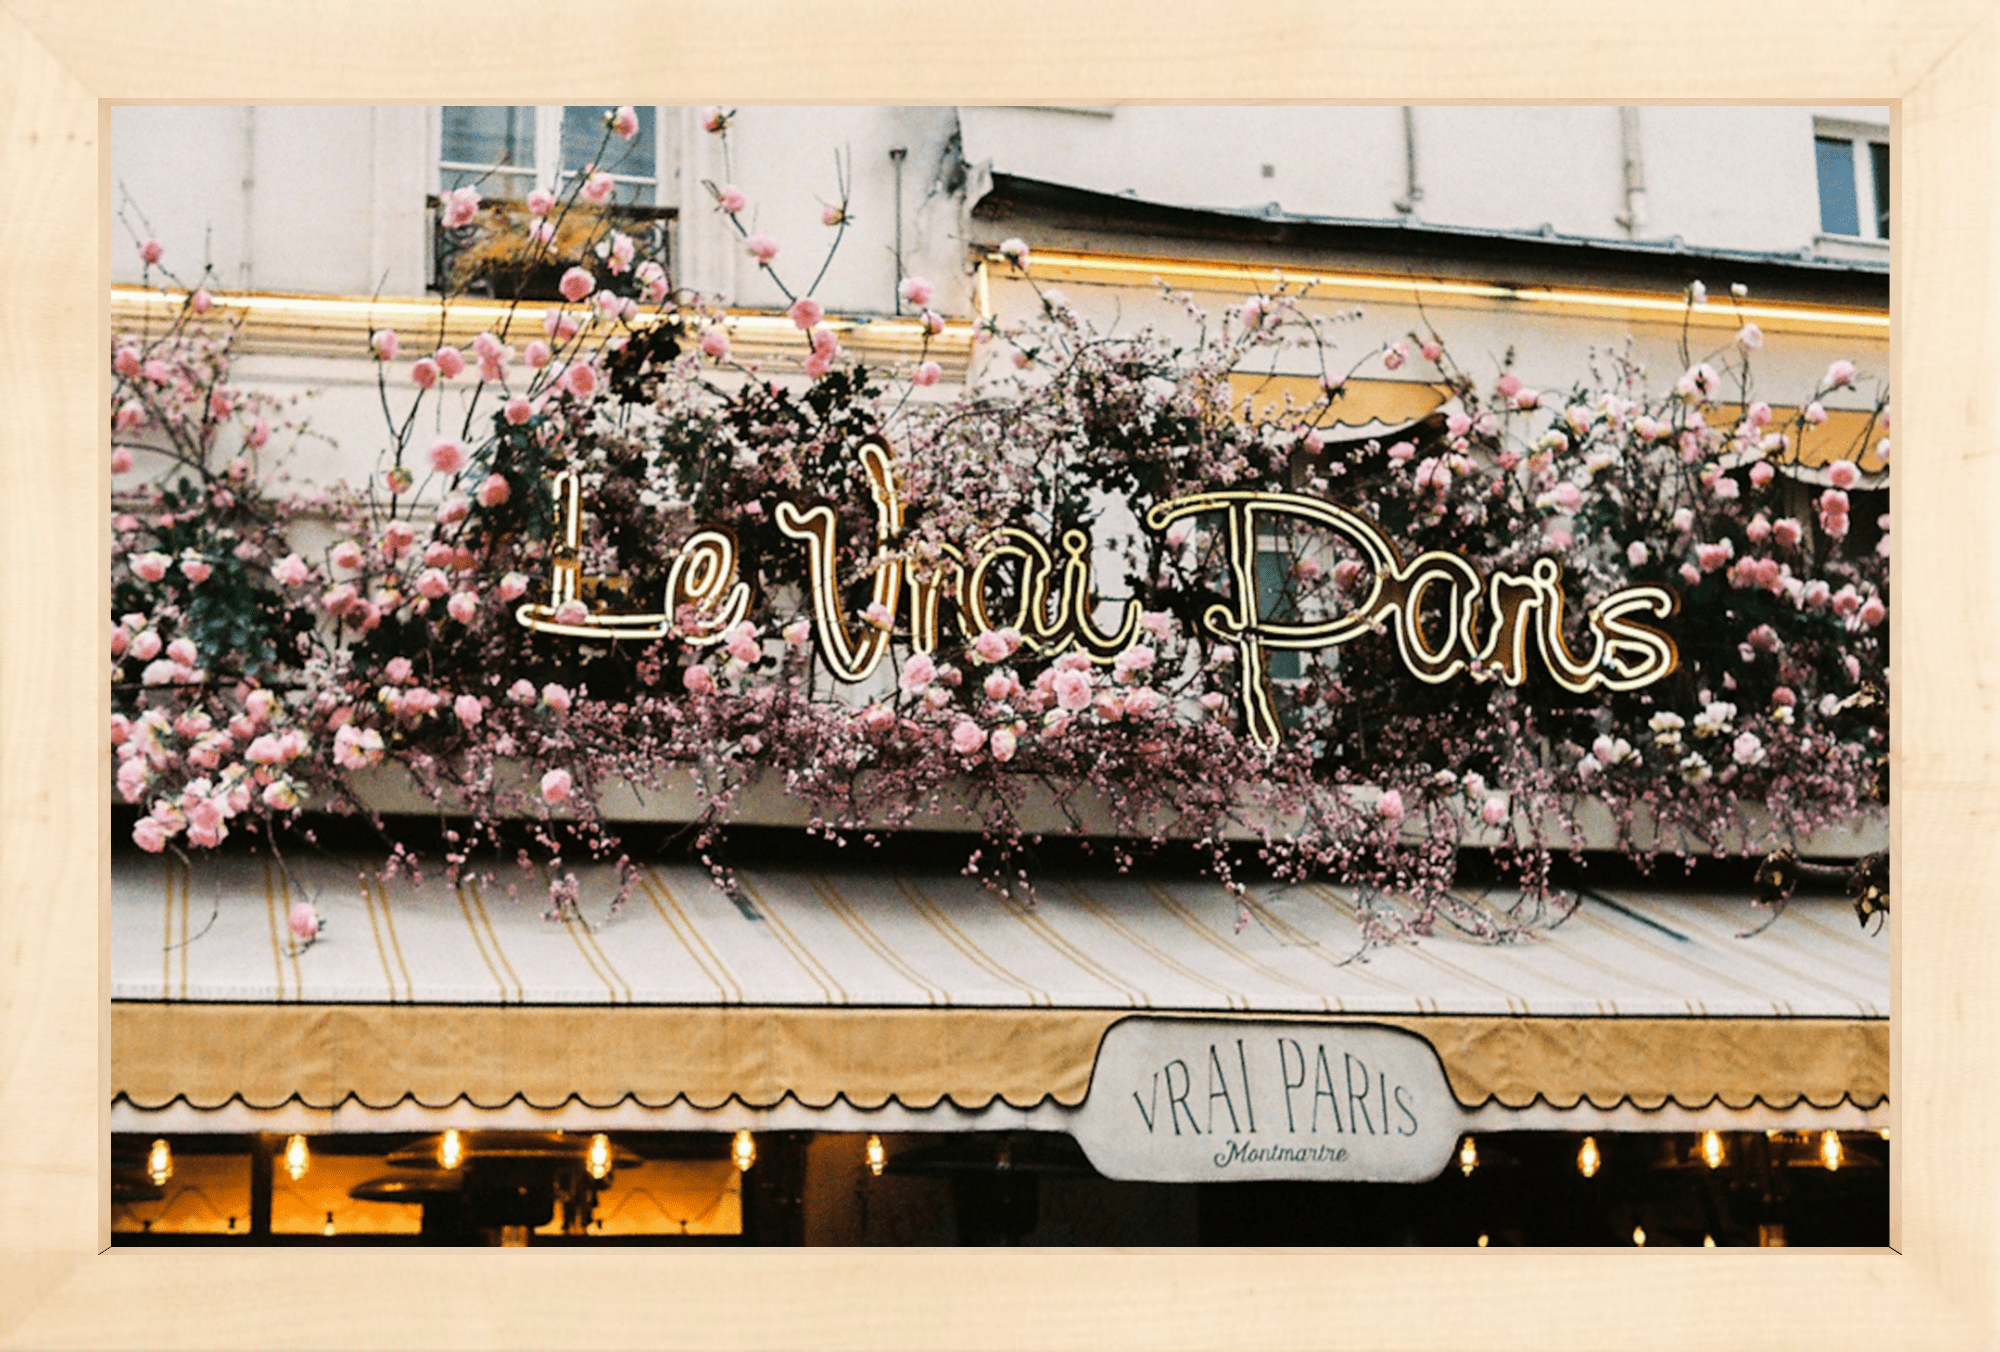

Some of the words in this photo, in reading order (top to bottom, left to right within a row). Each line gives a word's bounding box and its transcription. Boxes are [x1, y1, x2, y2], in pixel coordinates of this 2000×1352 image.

[515, 469, 751, 646] Le
[775, 441, 1143, 682] Vrai
[1147, 490, 1680, 751] Paris
[1132, 1038, 1257, 1136] VRAI
[1278, 1037, 1419, 1138] PARIS
[1213, 1139, 1350, 1168] Montmartre
